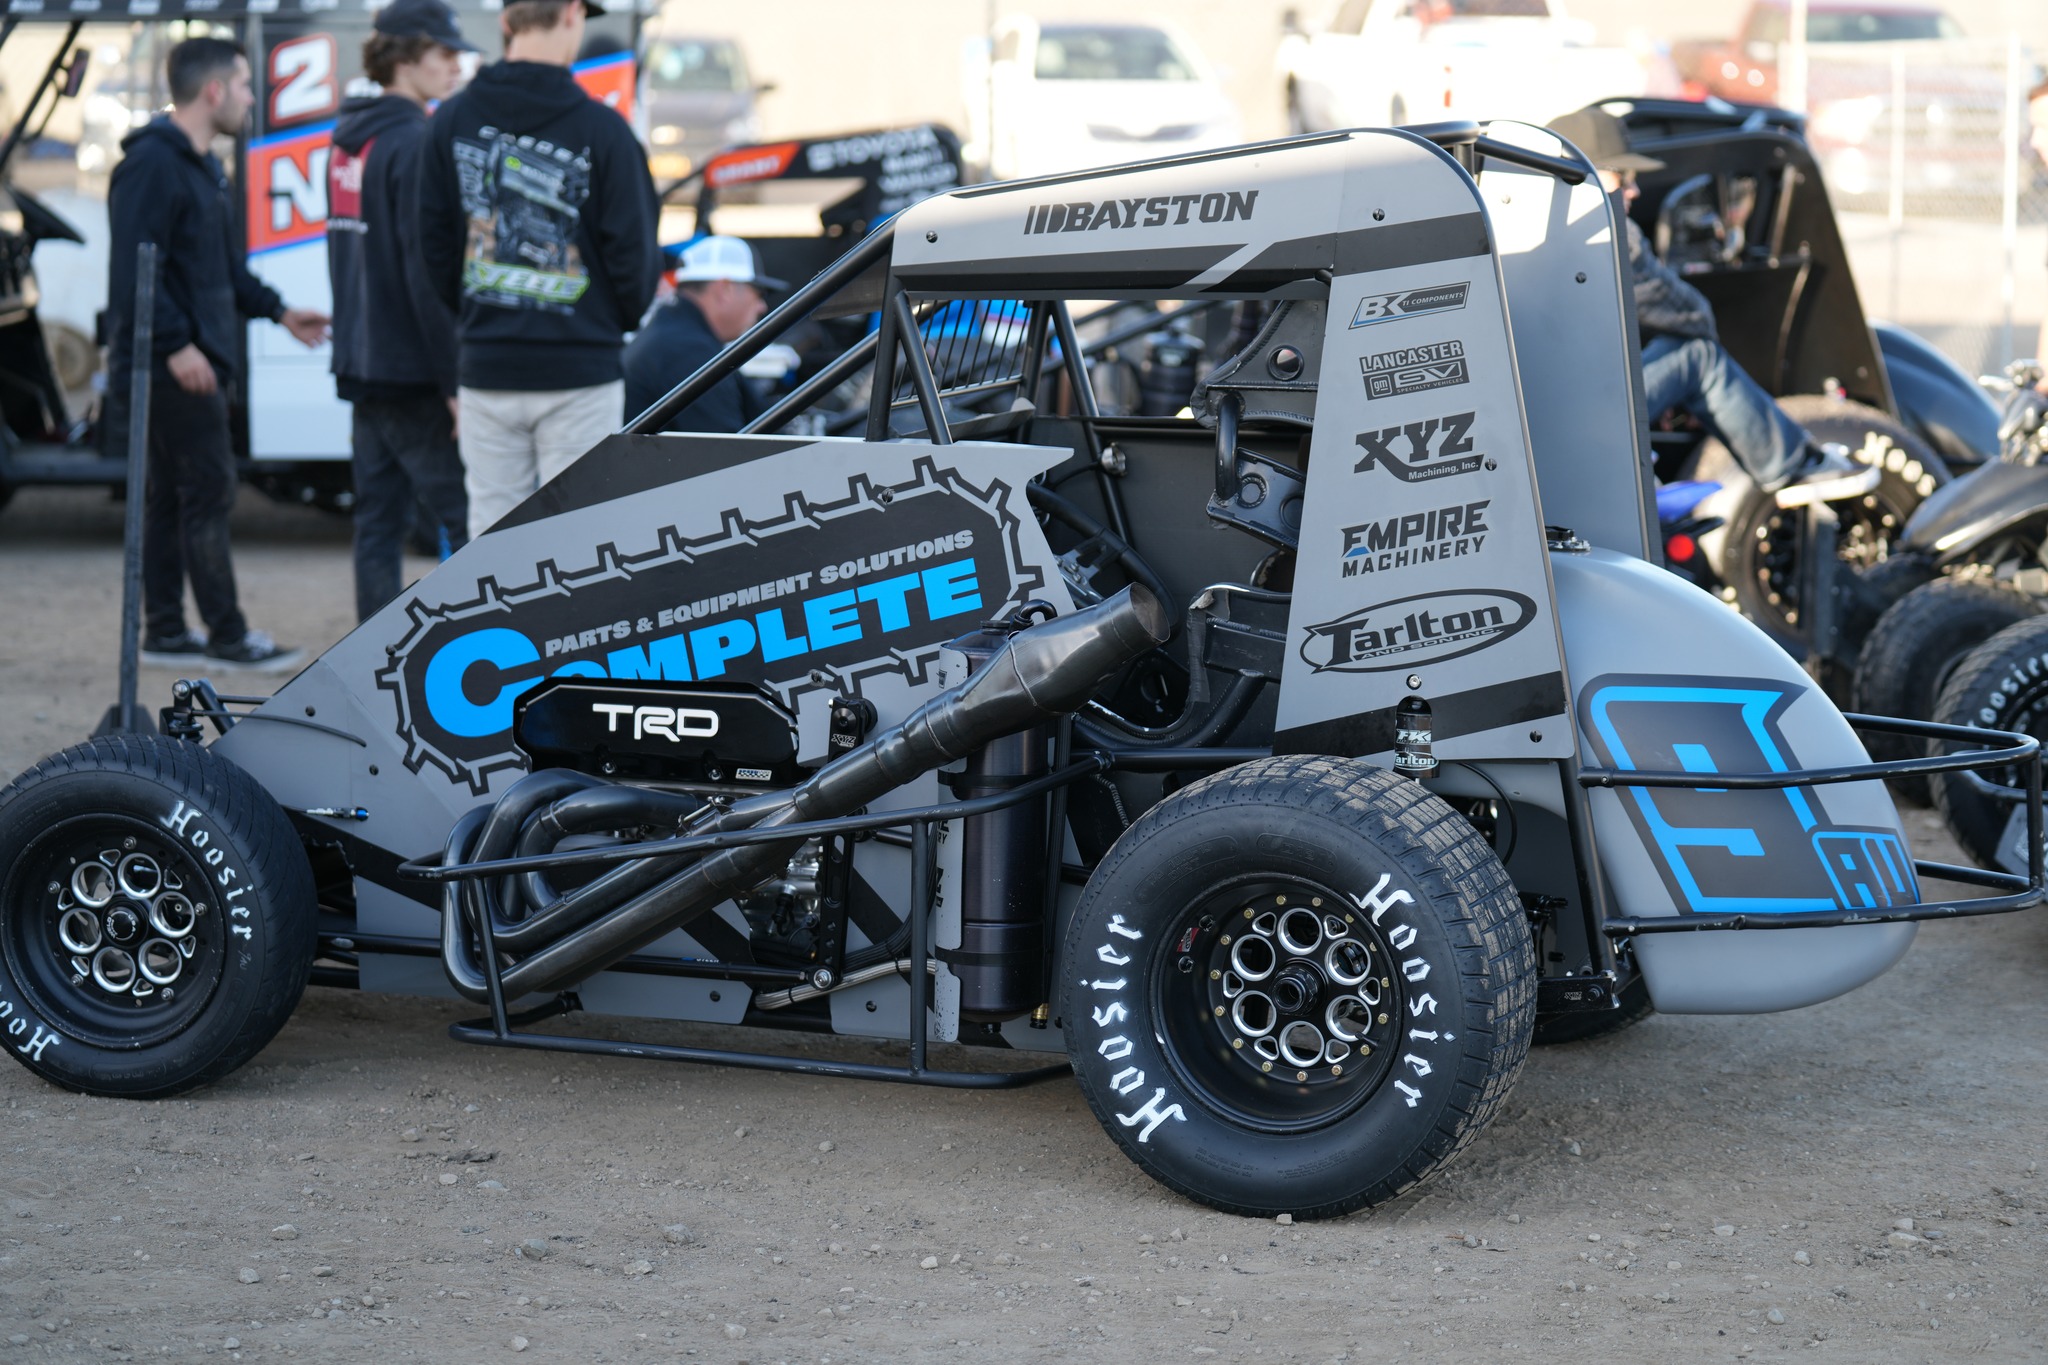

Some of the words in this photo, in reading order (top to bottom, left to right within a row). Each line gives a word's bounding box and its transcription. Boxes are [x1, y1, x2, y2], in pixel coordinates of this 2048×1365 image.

[274, 36, 333, 119] 2
[270, 147, 331, 232] N
[1060, 190, 1260, 233] BAYSTON
[1359, 292, 1413, 320] BK
[1411, 291, 1464, 305] COMPONENTS
[1360, 340, 1464, 373] LANCASTER
[1373, 379, 1389, 392] gm
[1396, 383, 1431, 394] SPECIALTY
[1433, 377, 1464, 387] VEHICLES
[1354, 411, 1475, 474] XYZ
[1408, 464, 1459, 480] Machining,
[1461, 460, 1479, 471] Inc.
[1341, 500, 1491, 558] EMPIRE
[1342, 535, 1485, 578] MACHINERY
[545, 620, 632, 658] PARTS
[636, 616, 653, 633] &
[658, 571, 813, 627] EQUIPMENT
[820, 530, 975, 584] SOLUTIONS
[1314, 606, 1504, 668] Tarlton
[1361, 645, 1407, 660] AND
[1411, 636, 1454, 649] SON
[1459, 628, 1501, 640] INC.
[592, 703, 719, 742] TRD
[160, 800, 253, 941] Hoosier
[1348, 872, 1456, 1108] Hoosier
[1077, 913, 1188, 1144] Hoosier
